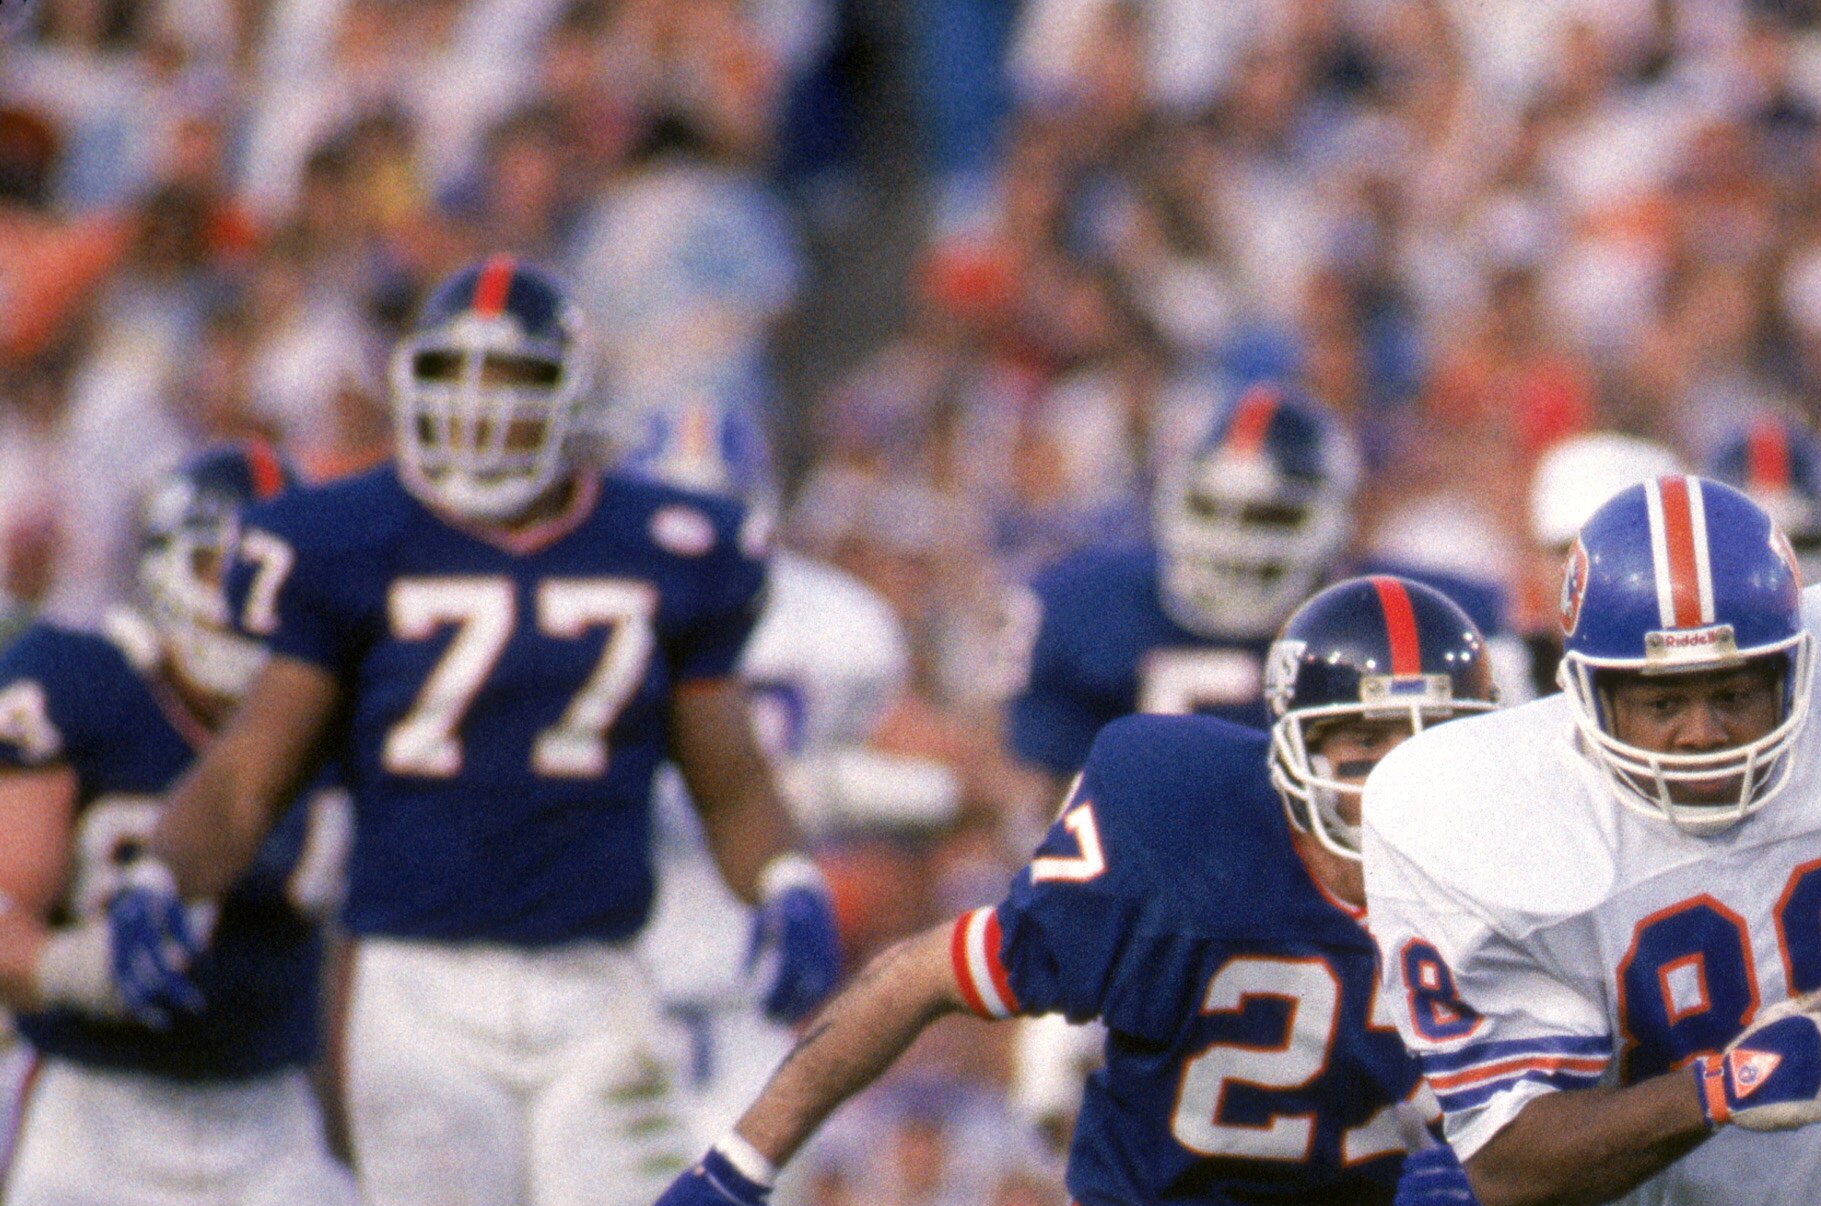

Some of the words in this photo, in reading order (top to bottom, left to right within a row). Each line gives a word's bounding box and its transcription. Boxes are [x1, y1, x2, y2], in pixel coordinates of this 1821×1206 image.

[383, 574, 657, 777] 77
[1665, 629, 1718, 648] Riddell
[1400, 936, 1485, 1043] 8
